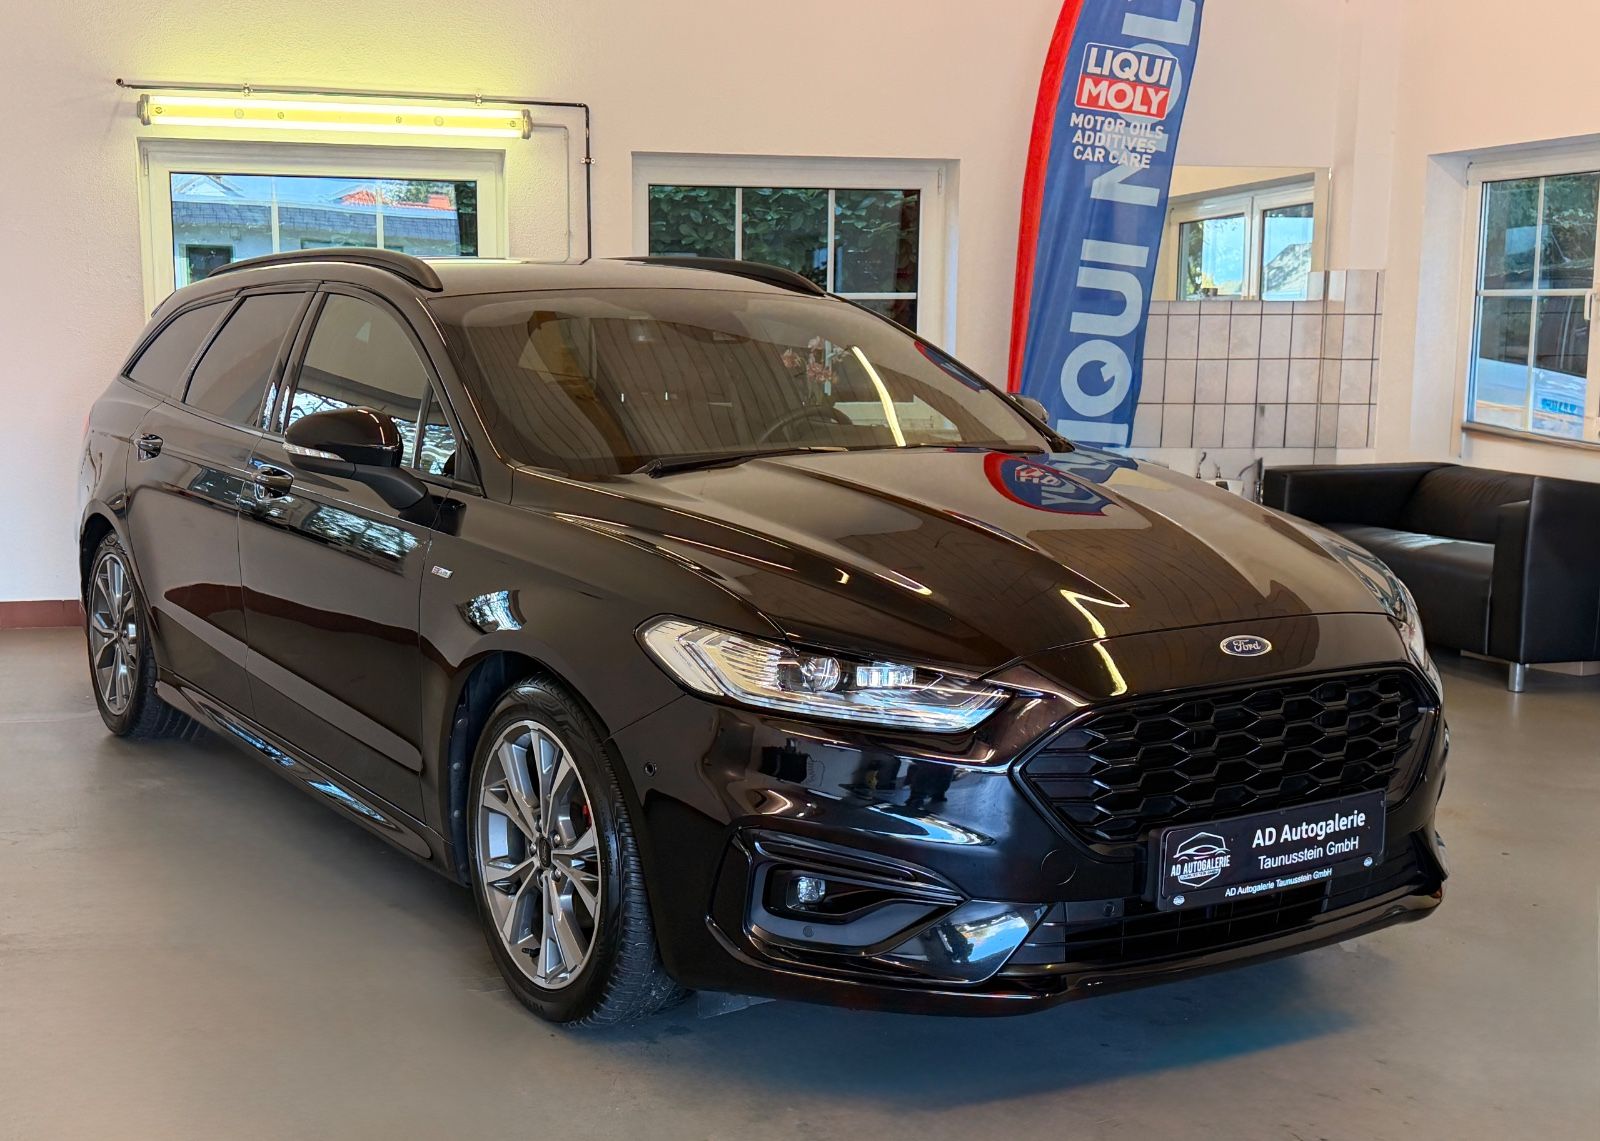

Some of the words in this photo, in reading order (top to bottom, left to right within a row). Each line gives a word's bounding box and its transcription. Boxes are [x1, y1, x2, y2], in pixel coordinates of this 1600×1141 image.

[1087, 47, 1172, 85] LIQUI
[1080, 78, 1168, 115] MOLY
[1070, 112, 1125, 134] MOTOR
[1129, 123, 1164, 140] OILS
[1072, 129, 1157, 154] ADDITIVES
[1073, 145, 1105, 162] CAR
[1109, 150, 1152, 169] CARE
[1057, 239, 1149, 446] IQUI
[1232, 639, 1261, 652] Ford
[1252, 827, 1276, 848] AD
[1280, 810, 1366, 843] Autogalerie
[1171, 864, 1183, 877] AD
[1183, 855, 1231, 874] AUTOGALERIE
[1258, 851, 1323, 870] Taunusstein
[1326, 836, 1359, 856] GmbH
[1225, 887, 1237, 897] AD
[1237, 881, 1275, 895] Autogalerie
[1276, 874, 1312, 888] Taunusstein
[1313, 867, 1333, 880] GmbH
